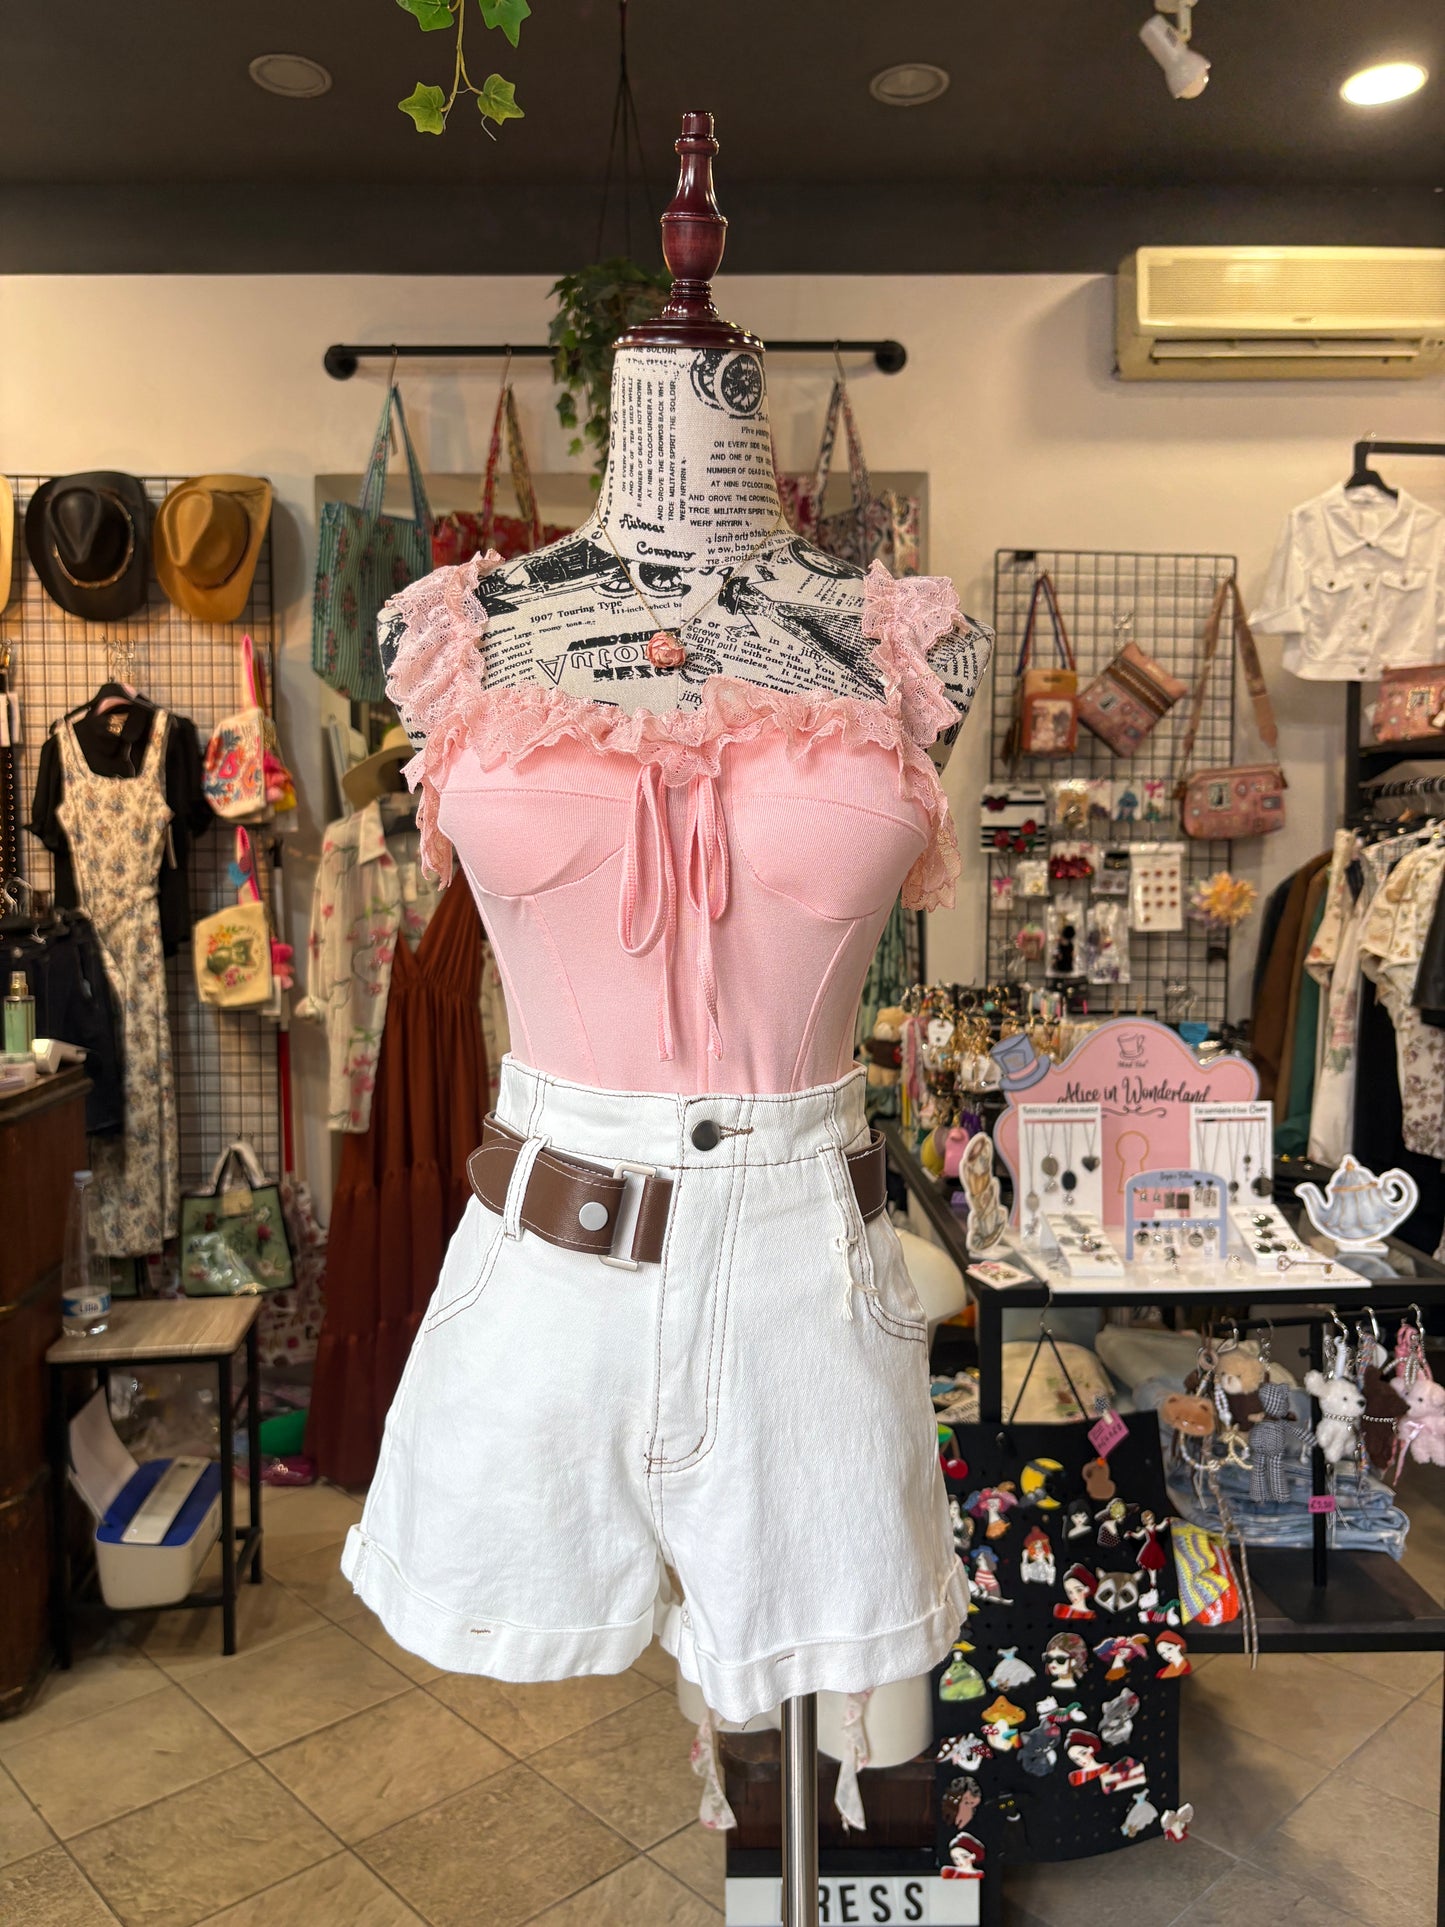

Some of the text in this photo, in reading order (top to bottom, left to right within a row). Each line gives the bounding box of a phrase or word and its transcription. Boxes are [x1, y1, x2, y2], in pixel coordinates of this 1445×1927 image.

[713, 440, 724, 448] ON
[728, 440, 748, 449] EVERY
[710, 453, 726, 461] AND
[728, 453, 742, 461] ONE
[706, 467, 737, 475] NUMBER
[738, 467, 746, 475] OF
[710, 480, 721, 488] AT
[647, 488, 653, 499] AT
[688, 494, 705, 502] AND
[735, 494, 748, 502] THE
[688, 506, 710, 515] TRCE
[713, 507, 747, 515] MILITARY
[748, 507, 766, 516] SPIRIT
[636, 541, 697, 560] Company
[529, 600, 623, 624] 1907 Touring Type
[707, 620, 721, 629] or
[768, 635, 780, 646] in
[787, 643, 794, 651] a
[686, 624, 721, 640] screws
[726, 635, 738, 644] to
[743, 640, 773, 654] tinker
[779, 650, 804, 665] with.
[814, 662, 835, 676] You
[504, 657, 534, 671] KNOWN
[685, 632, 716, 647] slight
[716, 641, 738, 653] pull
[740, 648, 762, 660] with
[765, 656, 784, 666] one
[785, 660, 811, 676] hand
[814, 672, 836, 685] puts
[840, 681, 848, 690] it
[780, 668, 790, 677] It
[792, 672, 801, 680] is
[1057, 1075, 1212, 1104] Alice in Wonderland
[781, 1882, 923, 1923] RESS
